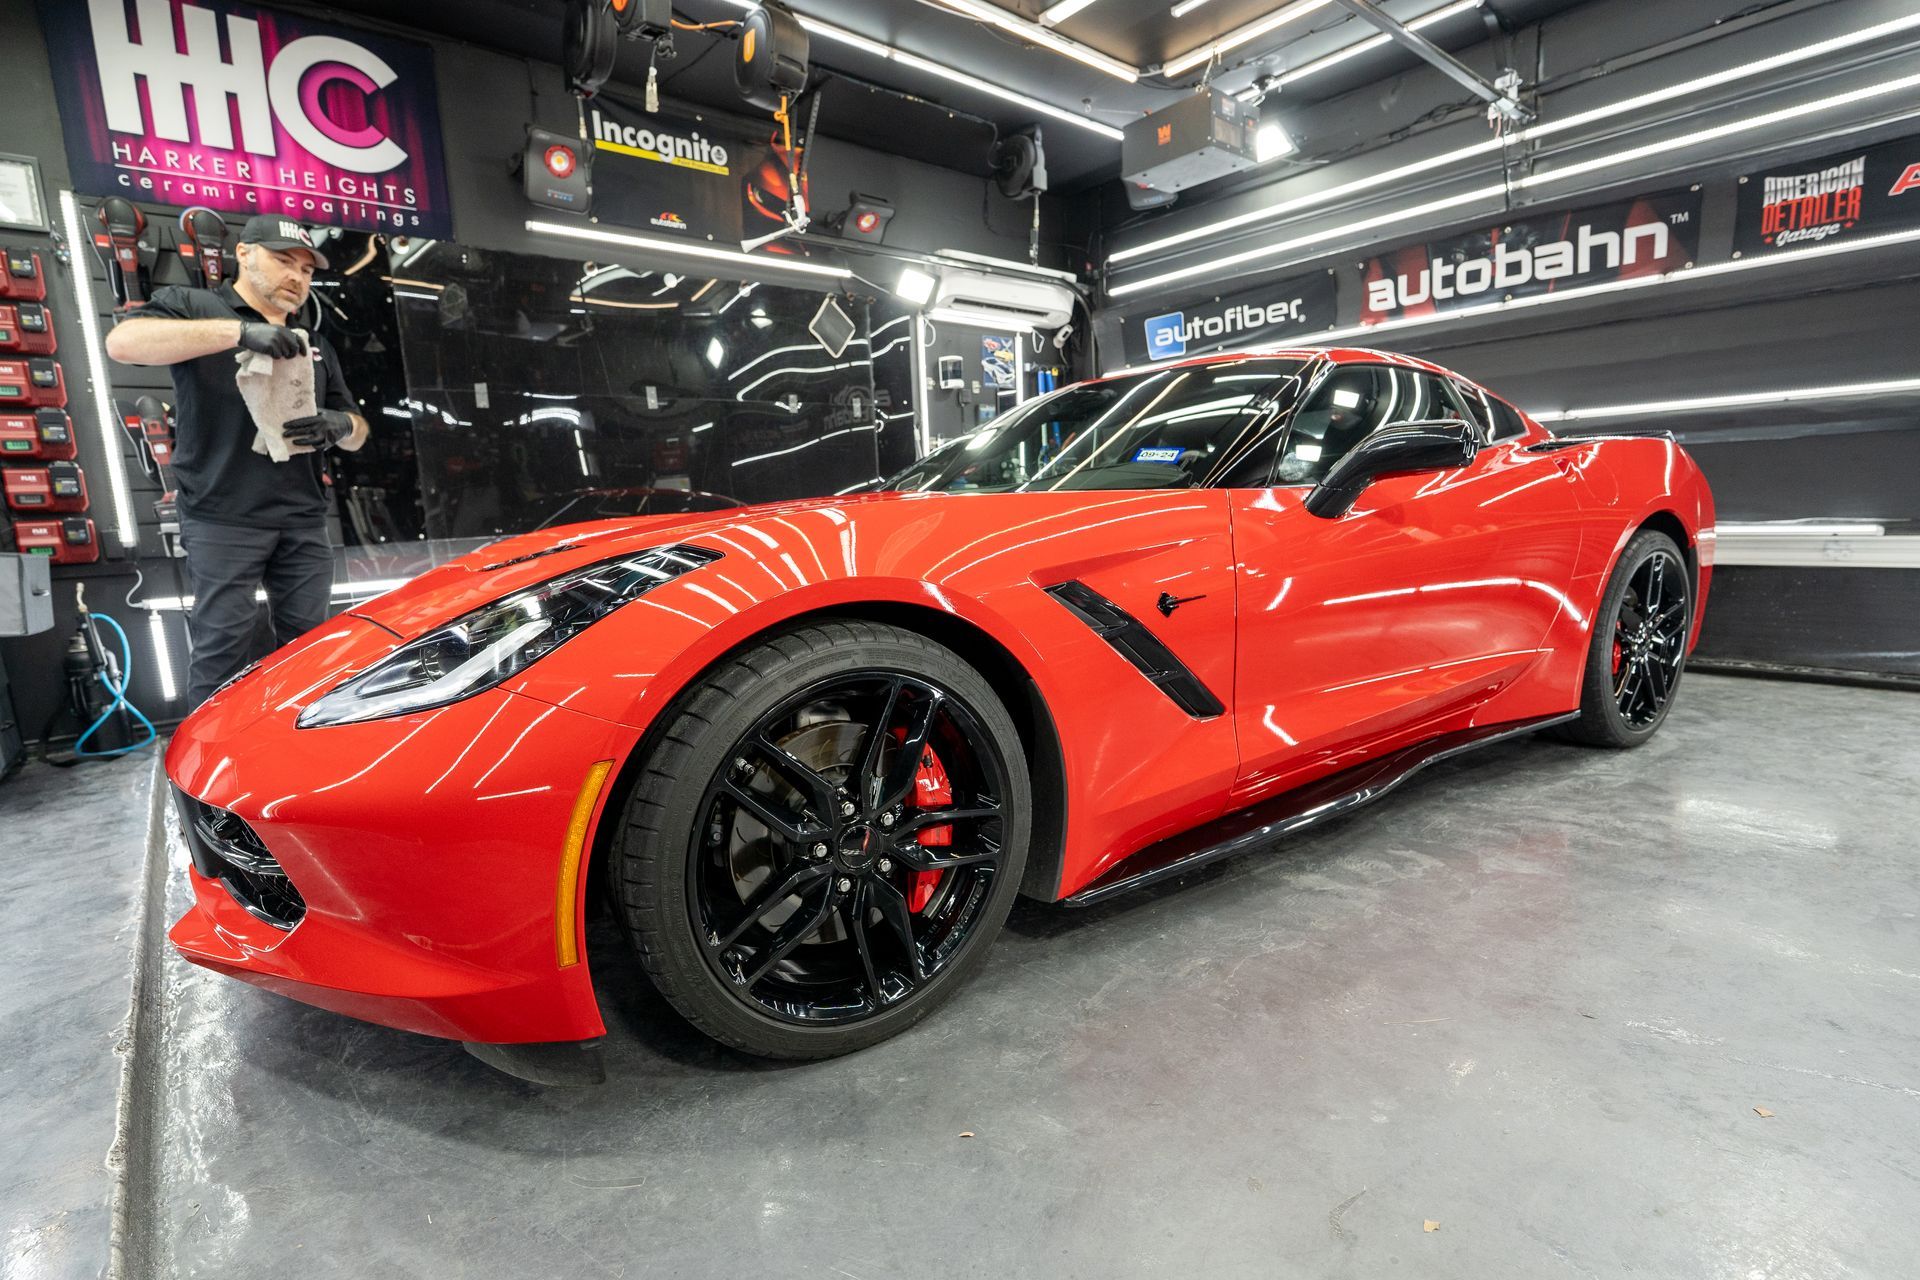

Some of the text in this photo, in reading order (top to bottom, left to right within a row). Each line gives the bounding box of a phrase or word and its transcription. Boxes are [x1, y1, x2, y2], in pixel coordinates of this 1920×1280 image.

[592, 110, 728, 166] Incognito
[112, 141, 416, 205] HARKER HEIGHTS
[118, 172, 420, 227] ceramic coatings
[1762, 155, 1866, 208] AMERICAN
[1761, 186, 1862, 235] DETAILER
[1775, 223, 1841, 247] Garage
[1368, 221, 1669, 312] autobahn
